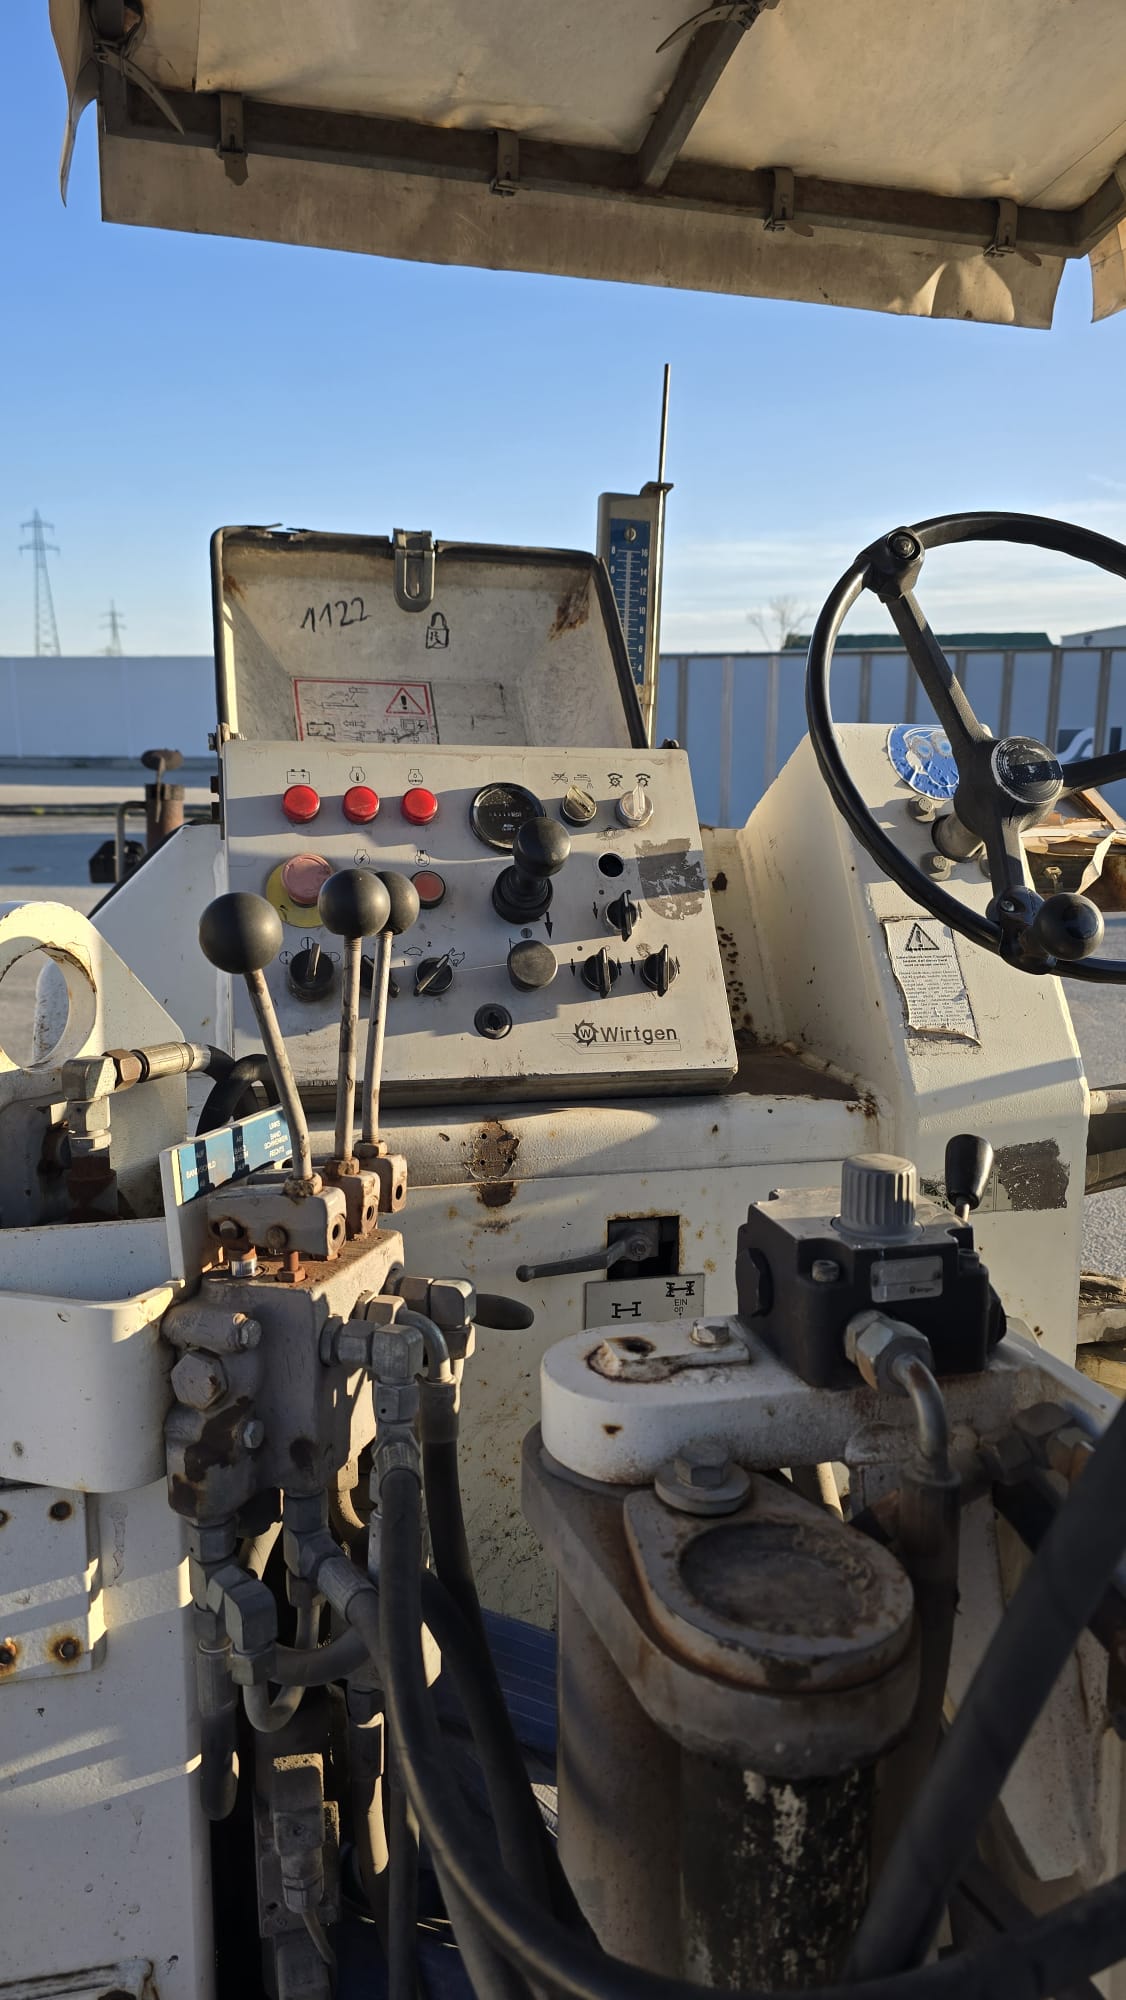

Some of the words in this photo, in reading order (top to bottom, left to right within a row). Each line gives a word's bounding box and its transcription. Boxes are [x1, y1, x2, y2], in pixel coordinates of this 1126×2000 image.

[641, 548, 648, 557] 16
[640, 569, 647, 577] 14
[639, 606, 646, 614] 10
[300, 597, 373, 632] 1122
[639, 626, 644, 634] 8
[638, 645, 643, 653] 6
[637, 664, 642, 672] 4
[600, 1026, 678, 1045] Wirtgen
[674, 1298, 688, 1306] EIN
